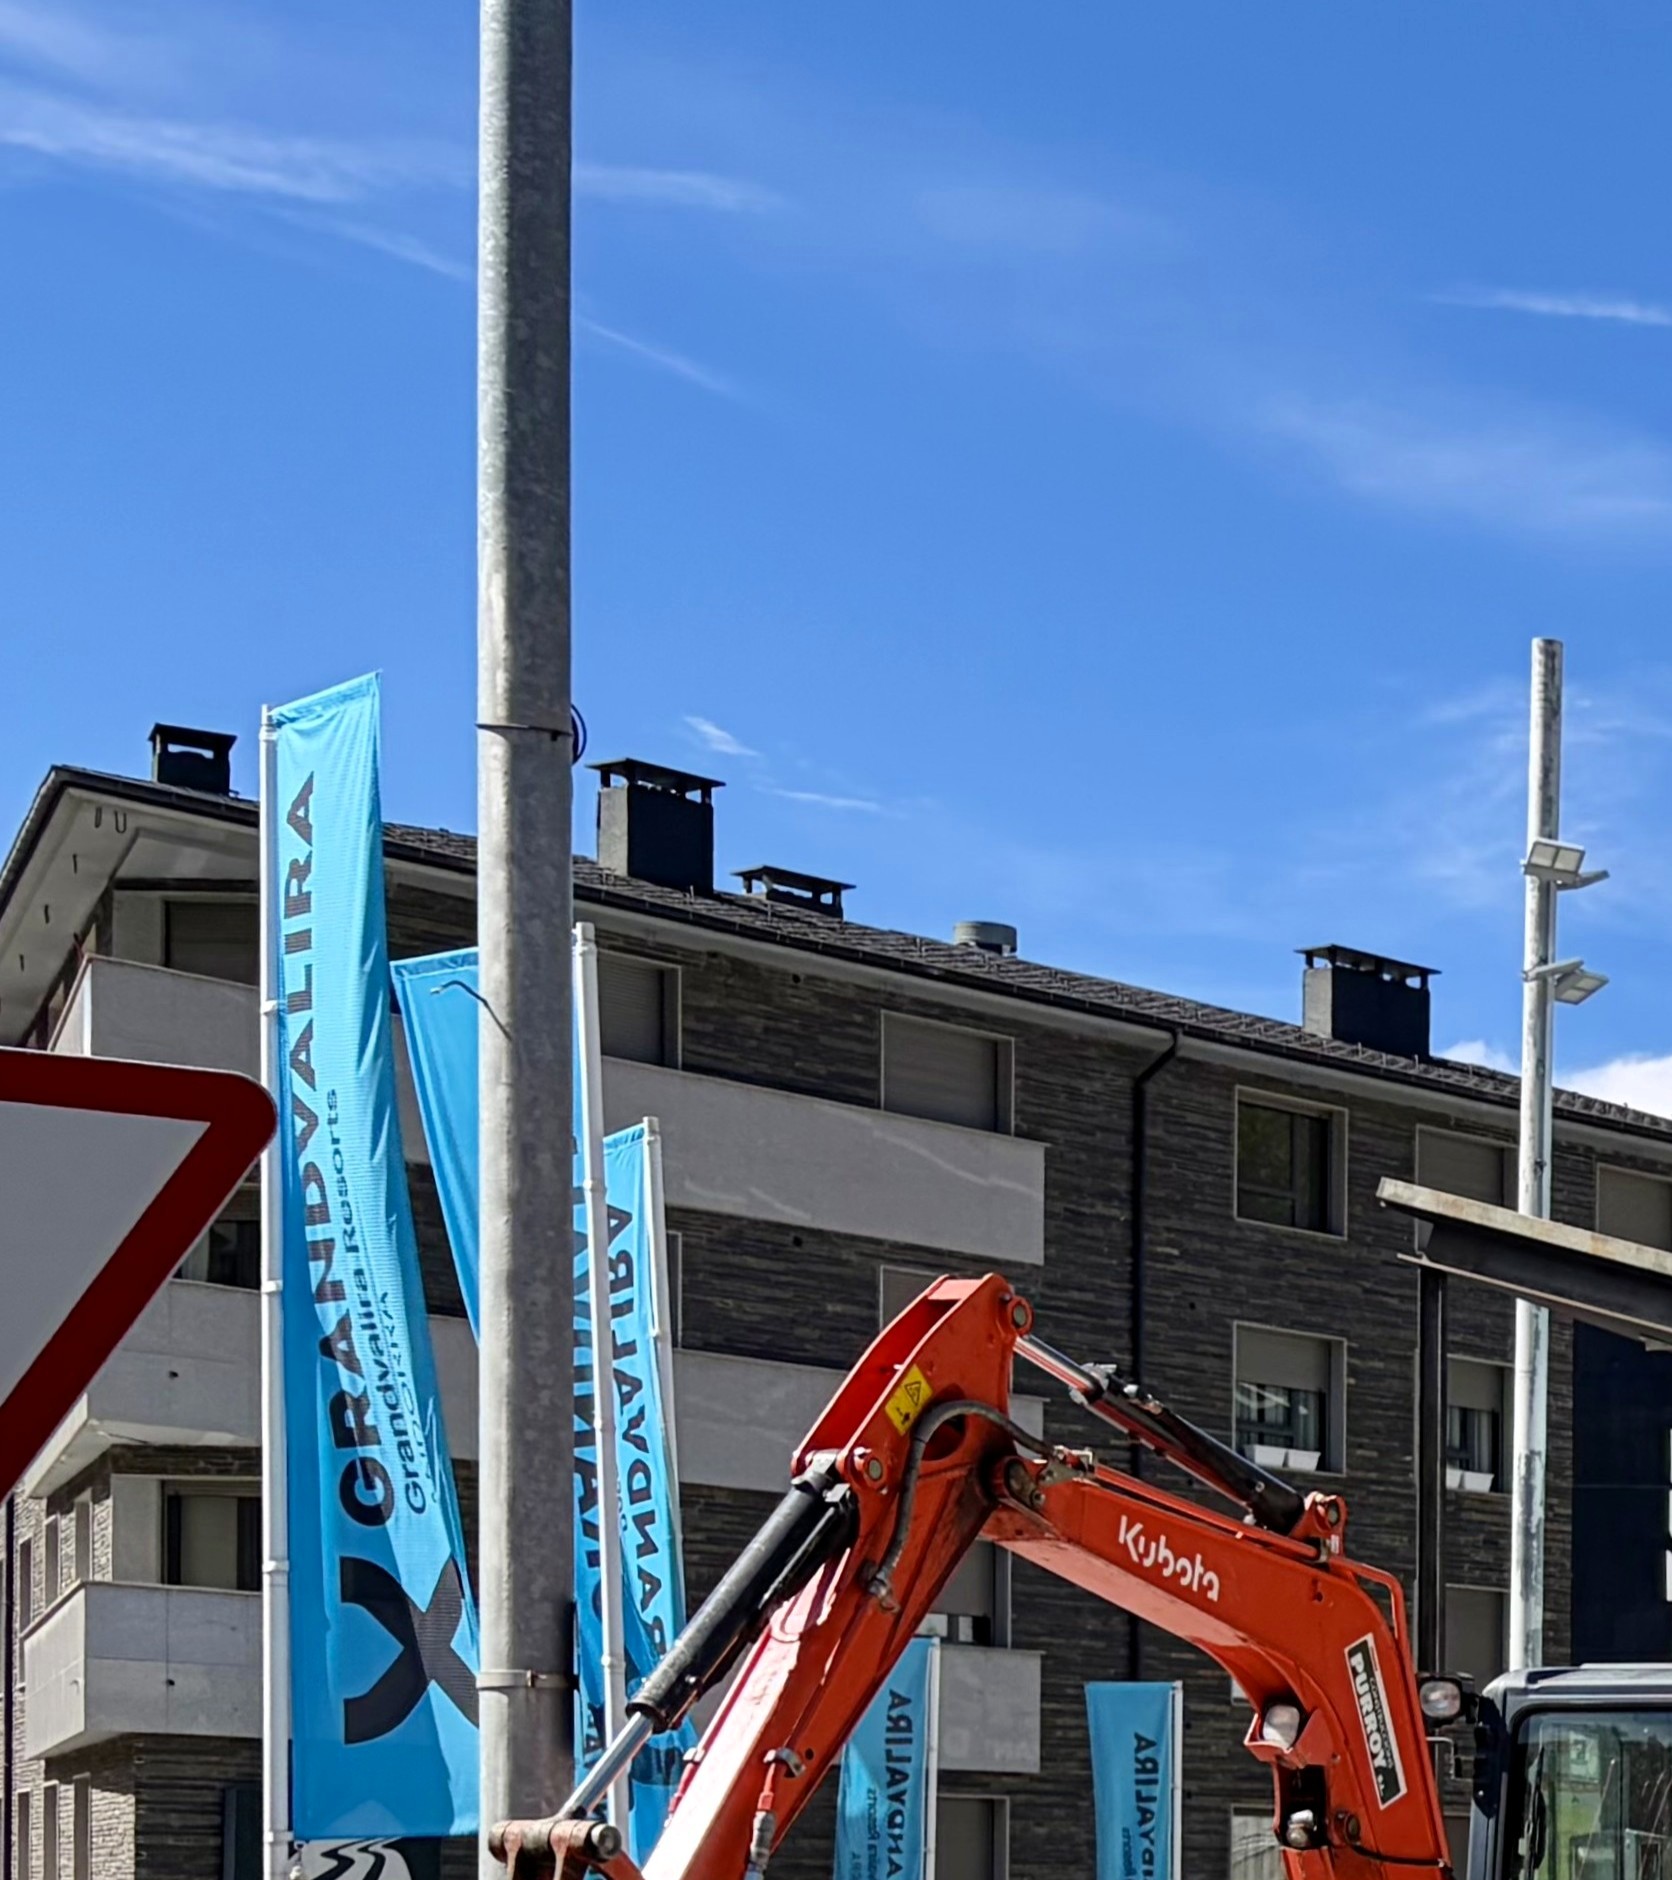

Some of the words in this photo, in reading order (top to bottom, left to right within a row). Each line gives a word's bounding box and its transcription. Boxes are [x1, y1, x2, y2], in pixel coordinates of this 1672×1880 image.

[283, 770, 394, 1528] GRANDVALIRA
[327, 1088, 359, 1255] Resorts
[353, 1267, 427, 1516] Grandvalira
[1118, 1514, 1220, 1602] Kubota
[1350, 1652, 1386, 1768] PURROY
